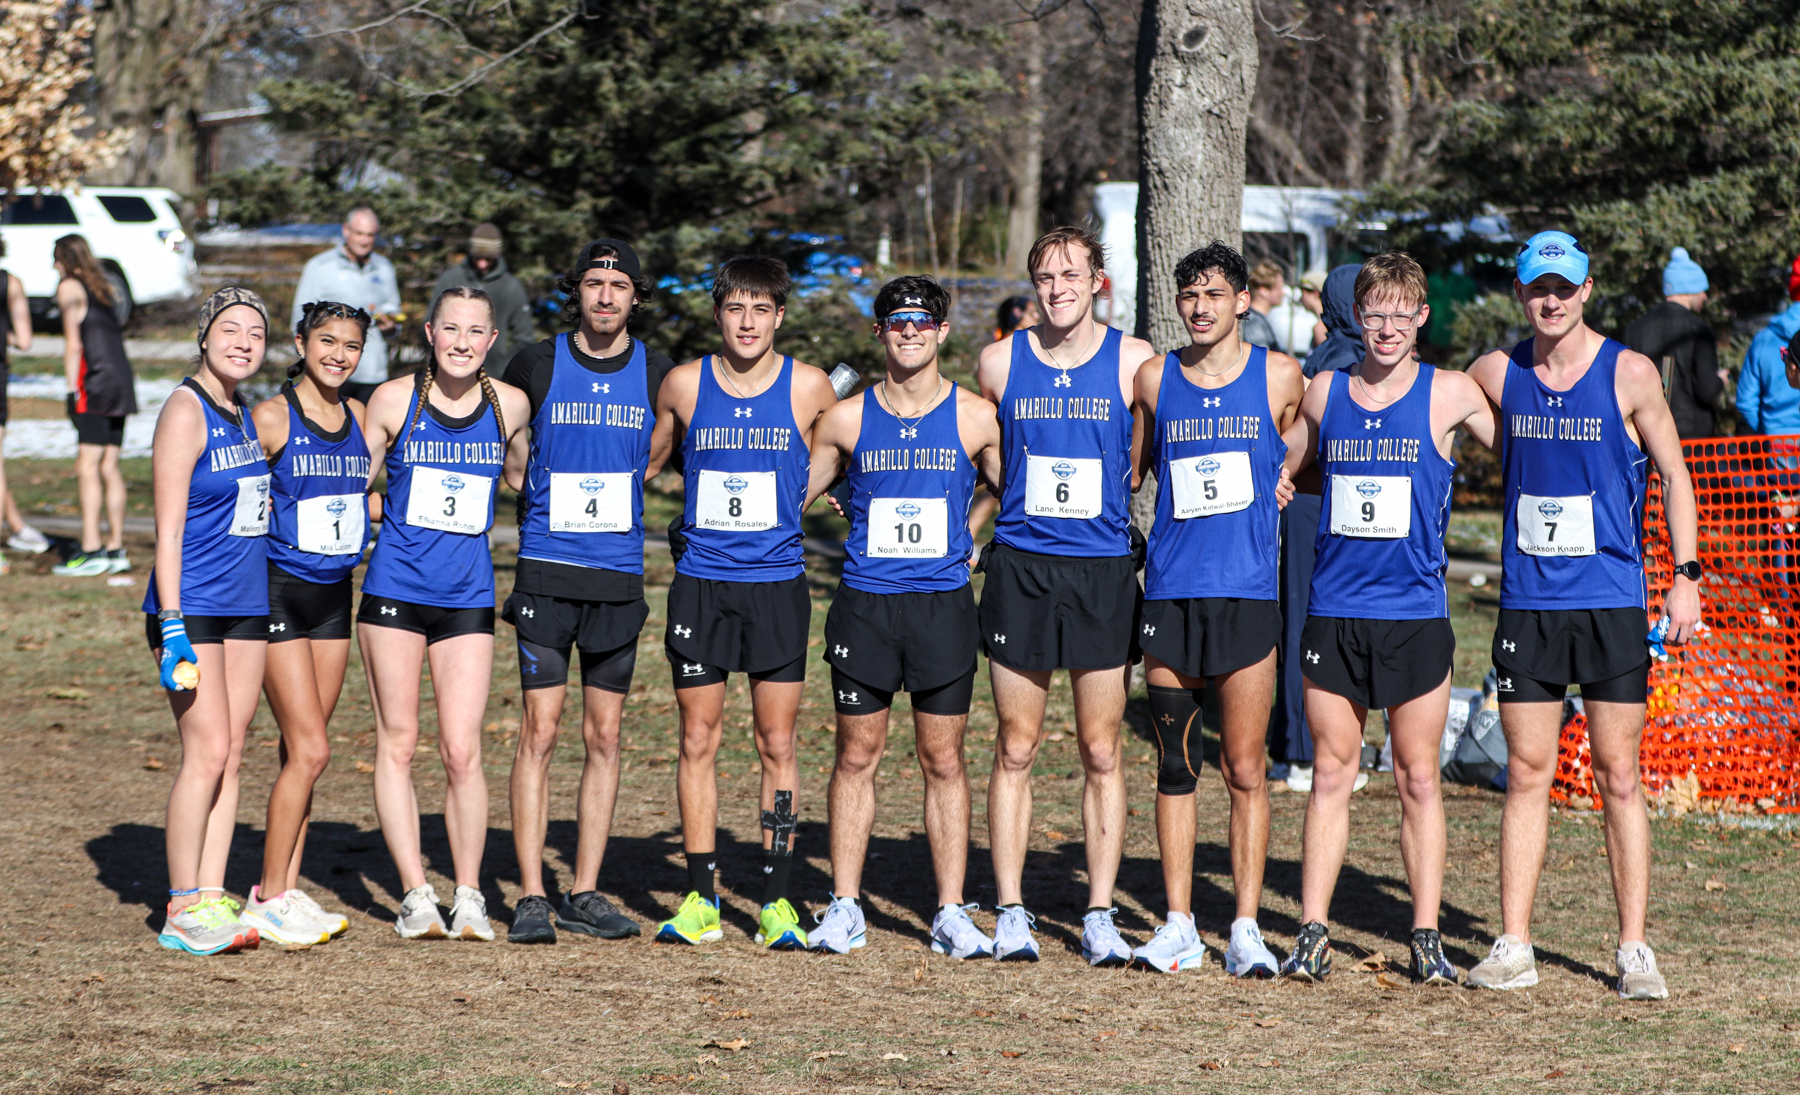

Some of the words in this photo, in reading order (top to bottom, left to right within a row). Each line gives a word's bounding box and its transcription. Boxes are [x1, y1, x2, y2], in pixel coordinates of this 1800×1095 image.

[551, 402, 601, 425] AMARILLO
[606, 404, 645, 430] COLLEGE
[1014, 397, 1063, 421] AMARILLO
[1068, 397, 1111, 421] COLLEGE
[1166, 418, 1213, 443] AMARILLO
[1218, 416, 1260, 440] COLLEGE
[1512, 414, 1554, 440] AMARILLO
[1559, 417, 1602, 441] COLLEGE
[695, 427, 743, 451] AMARILLO
[748, 427, 791, 451] COLLEGE
[403, 441, 461, 463] AMARILLO
[861, 448, 909, 473] AMARILLO
[914, 448, 957, 472] COLLEGE
[1327, 439, 1373, 463] AMARILLO
[1377, 438, 1420, 463] COLLEGE
[293, 454, 342, 478] AMARILLO
[1056, 482, 1069, 503] 6
[1203, 479, 1218, 500] 5
[257, 500, 266, 521] 2
[443, 496, 456, 517] 3
[585, 498, 598, 518] 4
[728, 497, 742, 517] 8
[1035, 504, 1054, 513] Lane
[1058, 506, 1089, 516] Kenney
[1181, 507, 1202, 515] Aaryan
[1361, 501, 1375, 522] 9
[332, 520, 340, 540] 1
[453, 520, 475, 531] Rohm
[564, 521, 586, 529] Brian
[589, 521, 618, 529] Corona
[704, 519, 730, 528] Adrian
[735, 520, 768, 528] Rosales
[895, 523, 922, 543] 10
[1341, 525, 1370, 534] Dayson
[1372, 526, 1397, 534] Smith
[1544, 522, 1558, 542] 7
[877, 546, 898, 554] Noah
[1525, 543, 1555, 553] Jackson
[1557, 546, 1585, 554] Knapp
